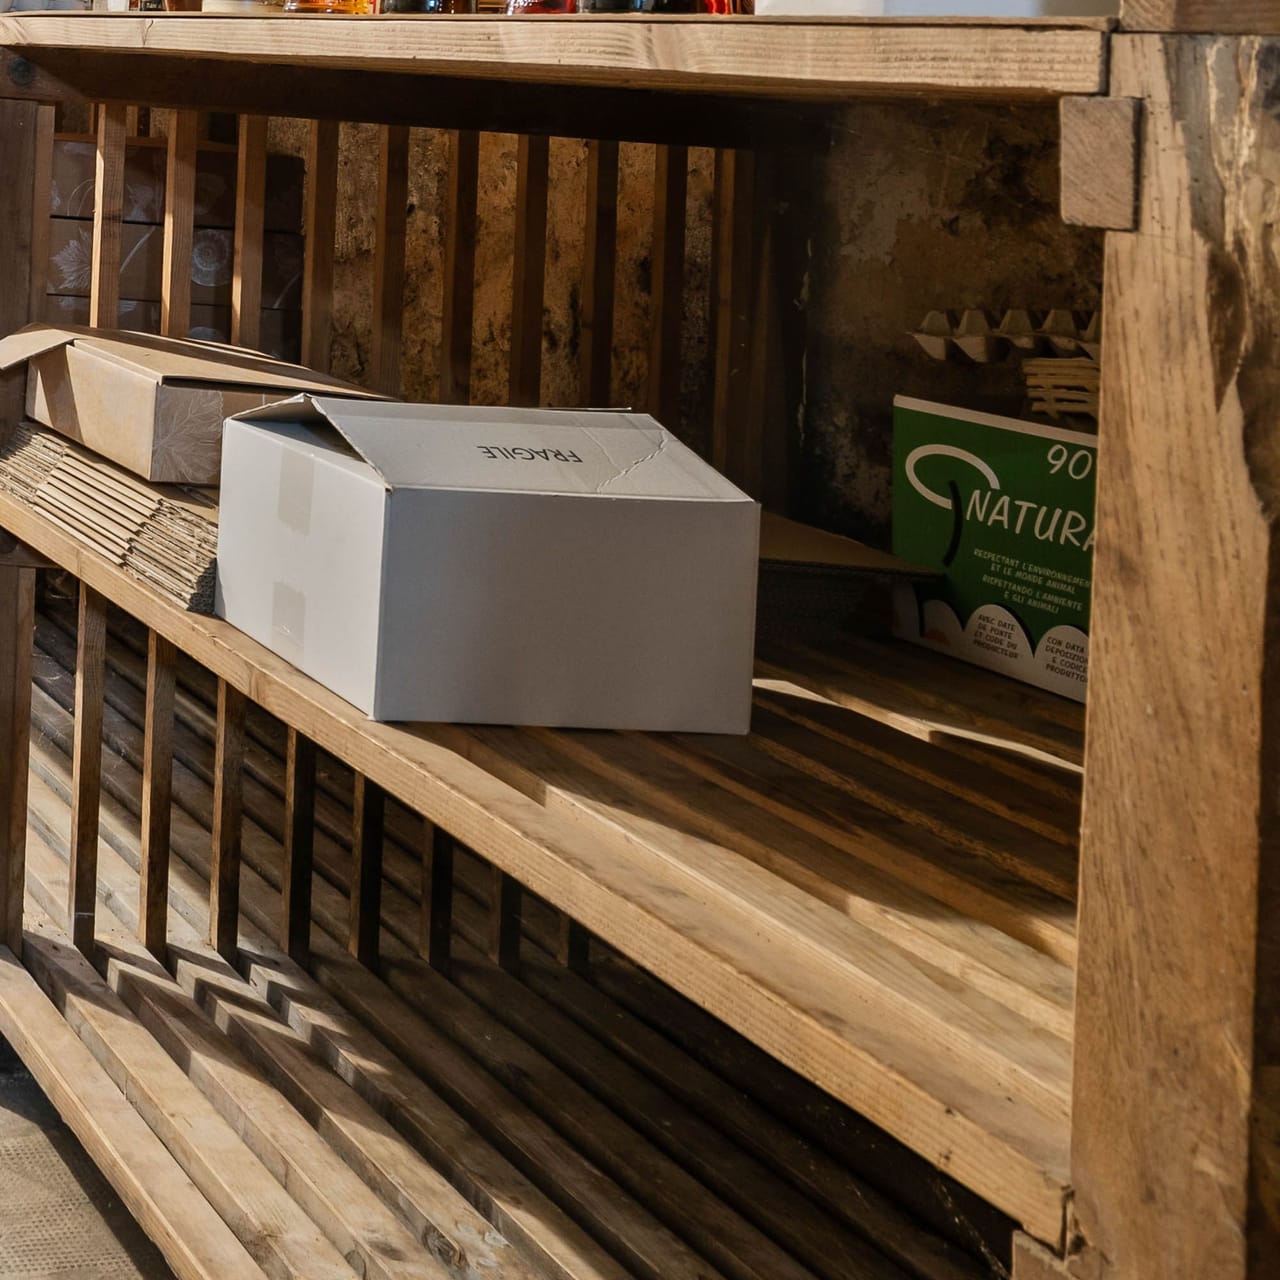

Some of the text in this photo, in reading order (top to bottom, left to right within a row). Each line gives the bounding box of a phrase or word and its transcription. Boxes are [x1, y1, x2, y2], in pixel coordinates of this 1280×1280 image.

[476, 445, 584, 463] FRAGILE
[1046, 443, 1092, 481] 90
[997, 619, 1016, 632] DATE
